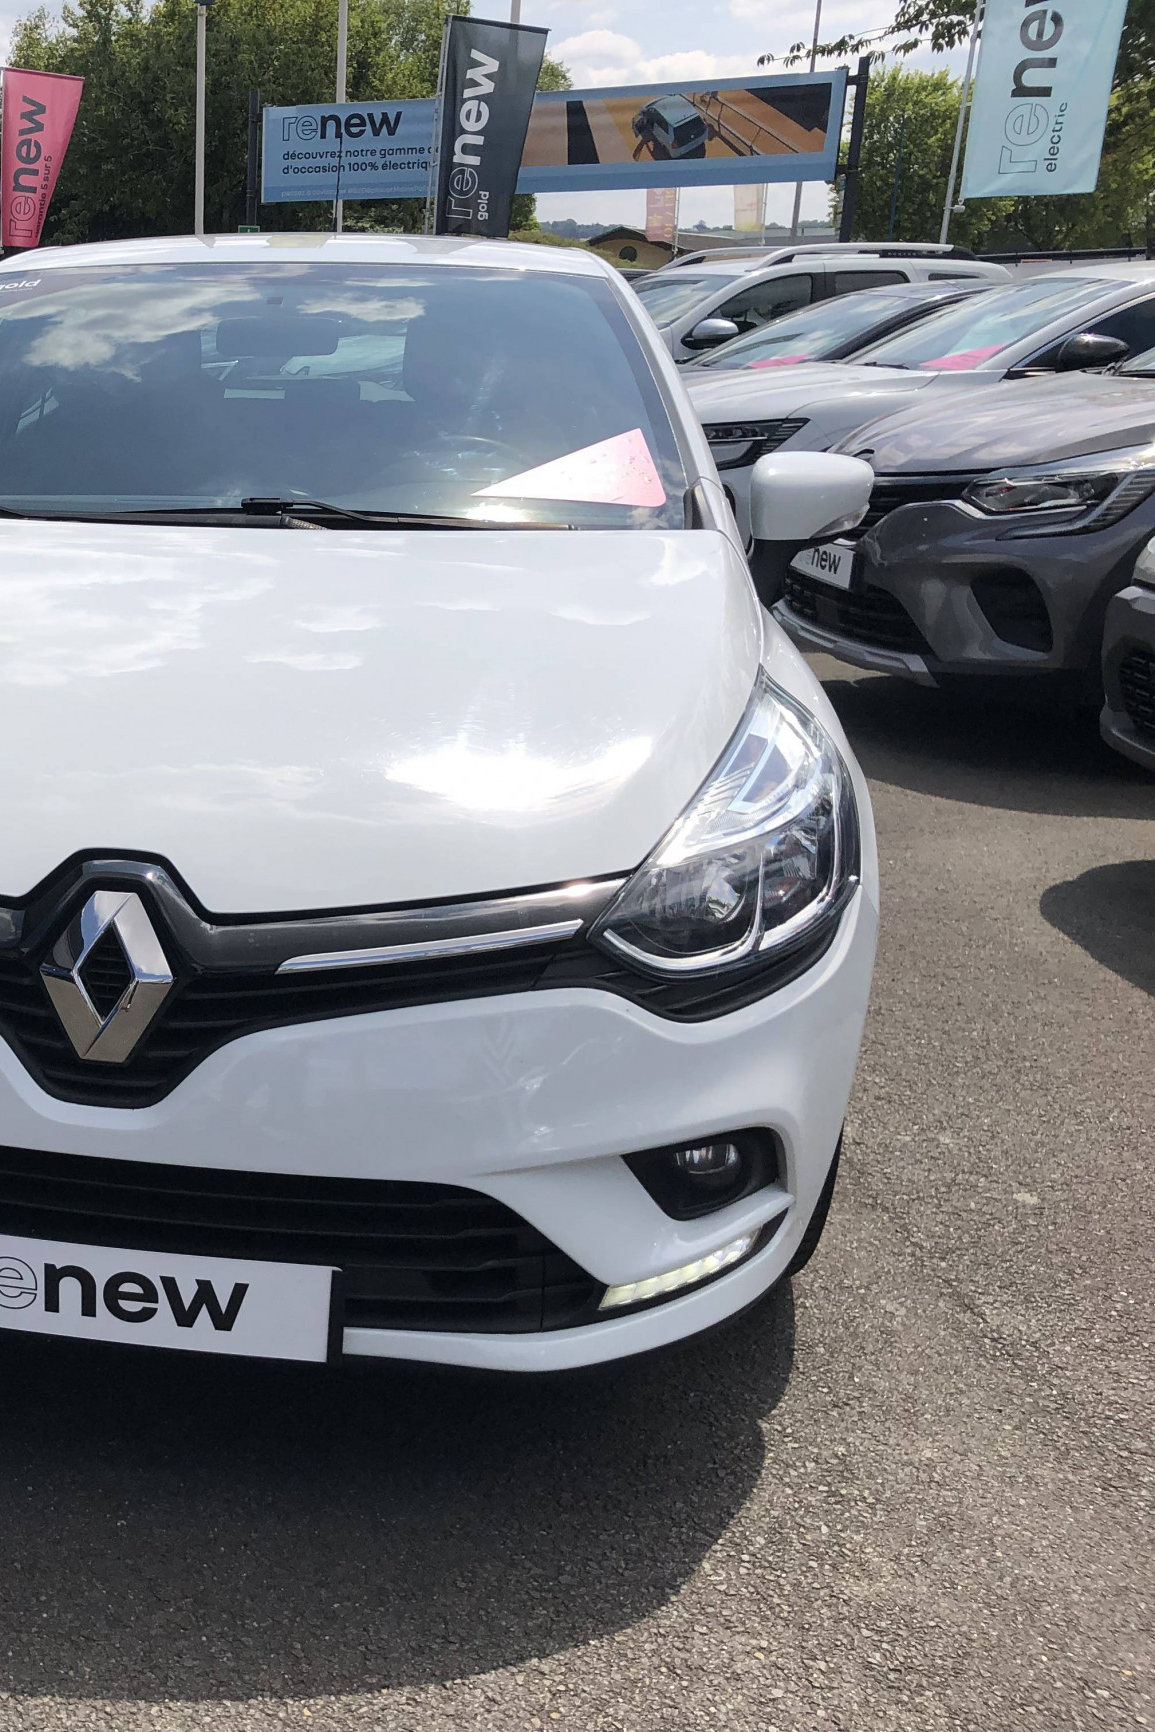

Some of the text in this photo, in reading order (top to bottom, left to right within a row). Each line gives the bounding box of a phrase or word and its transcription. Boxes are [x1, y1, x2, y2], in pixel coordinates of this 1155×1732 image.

[998, 0, 1065, 174] rene
[282, 111, 403, 142] renew
[446, 49, 500, 219] renew
[1043, 102, 1068, 173] electric
[9, 95, 47, 238] renew
[44, 155, 53, 163] 5
[282, 150, 343, 161] découvrez
[346, 148, 377, 158] notre
[379, 146, 424, 159] gamme
[282, 158, 432, 175] d'occasion 100% électriq
[477, 191, 489, 221] gold
